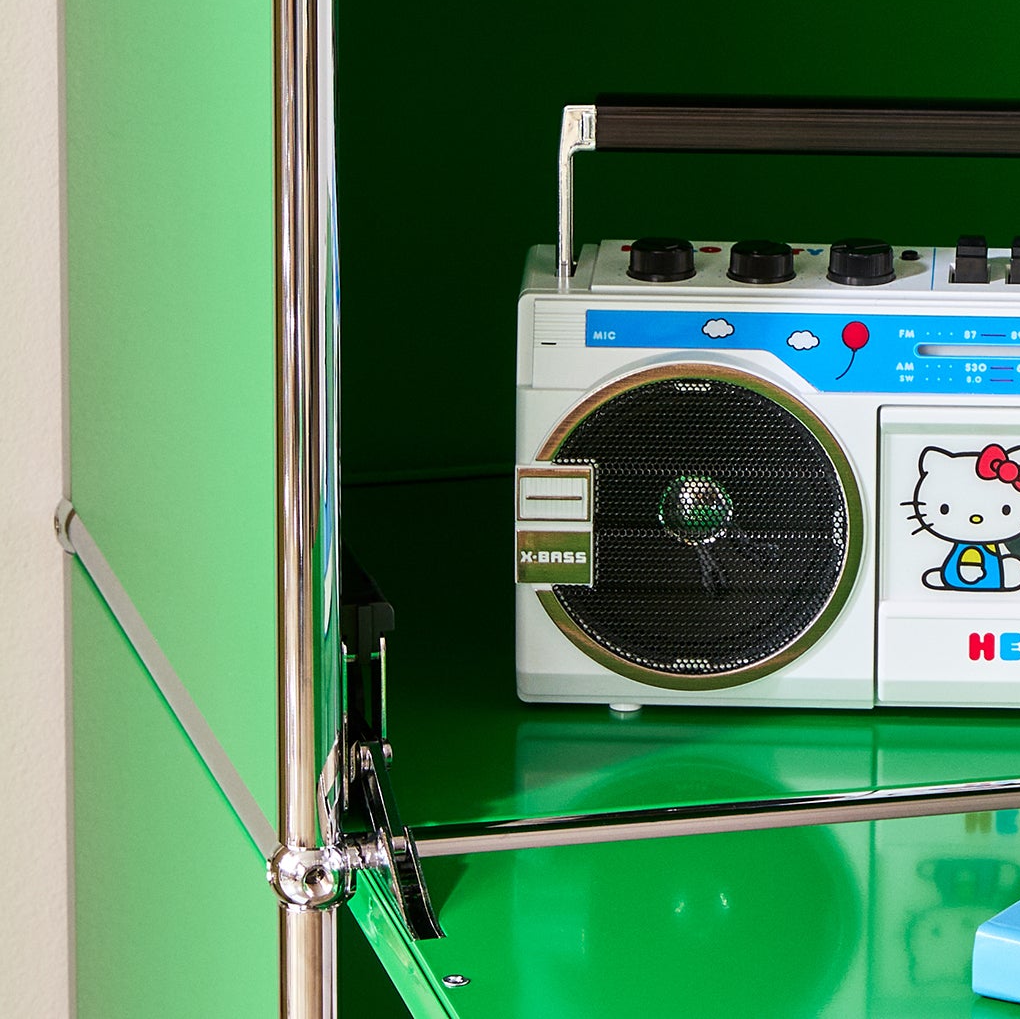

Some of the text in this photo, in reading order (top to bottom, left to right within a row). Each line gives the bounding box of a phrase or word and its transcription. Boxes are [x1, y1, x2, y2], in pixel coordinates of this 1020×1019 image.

[593, 331, 616, 340] MIC
[899, 330, 915, 338] FM
[964, 330, 977, 339] 87
[896, 362, 914, 371] AM
[965, 363, 987, 372] 530
